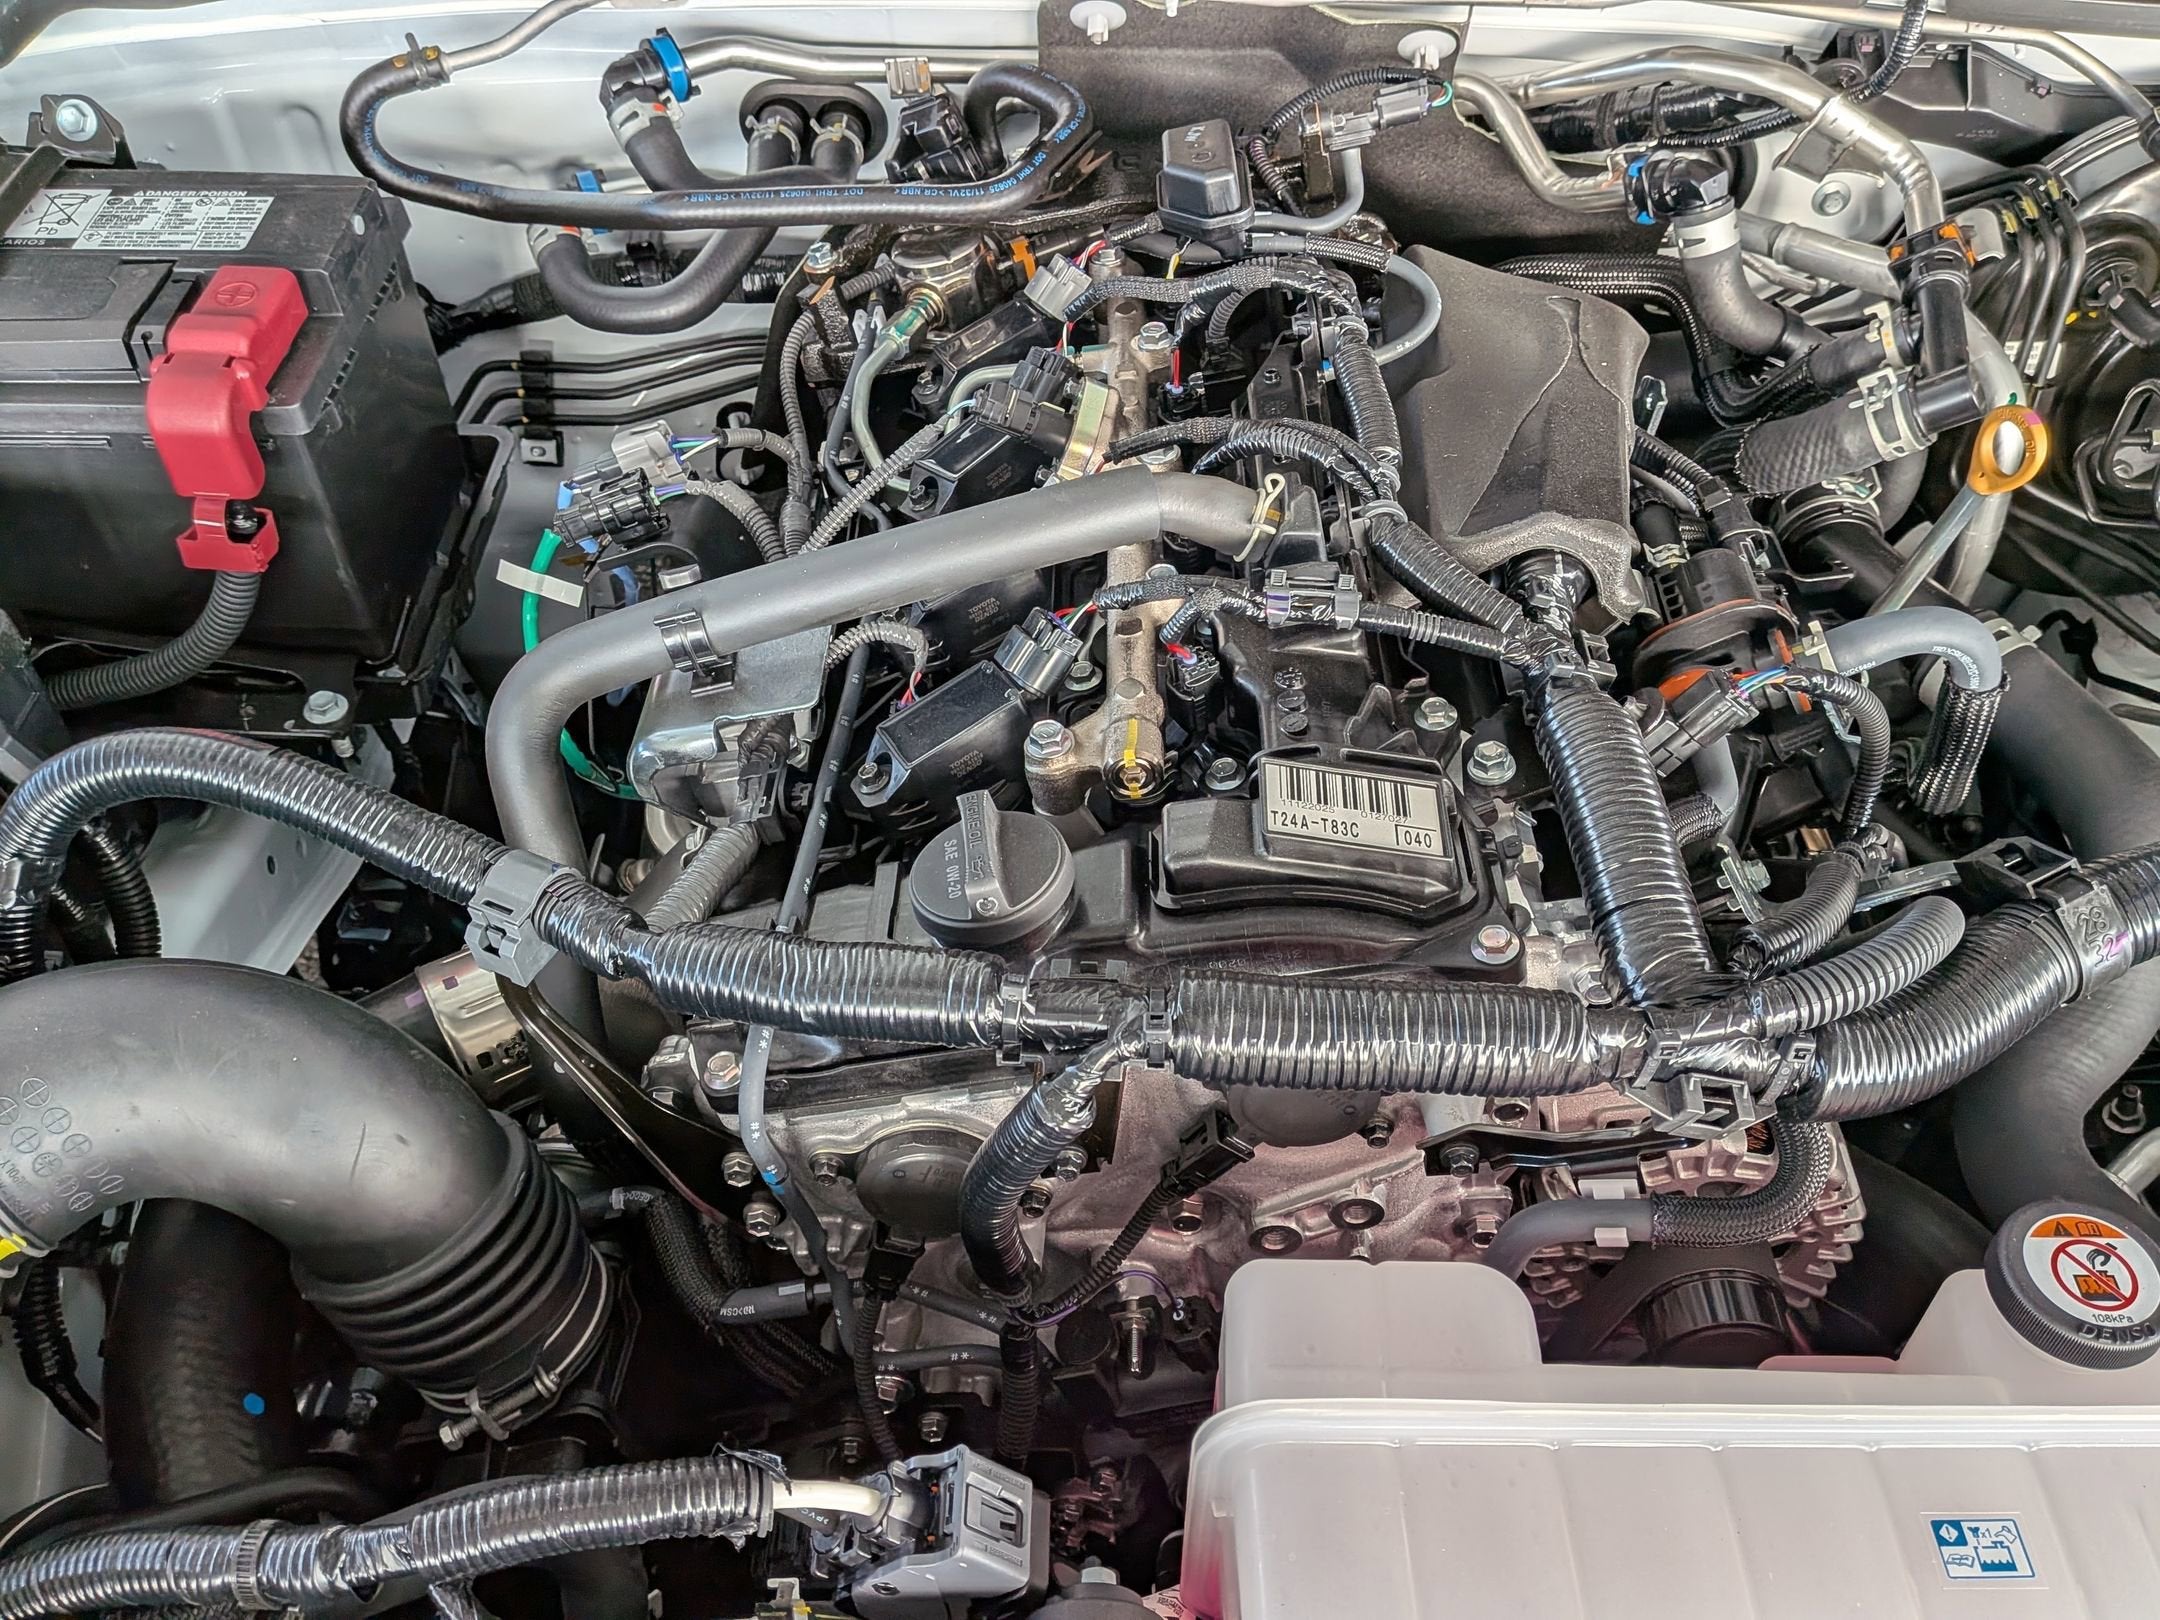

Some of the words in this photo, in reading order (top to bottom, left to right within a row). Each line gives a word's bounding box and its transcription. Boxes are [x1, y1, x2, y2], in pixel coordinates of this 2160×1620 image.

[1032, 152, 1047, 167] DOT
[145, 190, 248, 198] DANGER/POISON
[843, 188, 864, 196] DOT
[35, 226, 59, 236] Pb
[965, 793, 981, 830] ENGINE
[1270, 810, 1359, 838] T24A-T83C
[968, 832, 982, 850] OIL
[1404, 829, 1432, 849] 040
[943, 839, 959, 862] SAE
[2091, 1313, 2135, 1324] 108kPa
[2078, 1321, 2157, 1345] DENSO
[1981, 1527, 1993, 1539] x1
